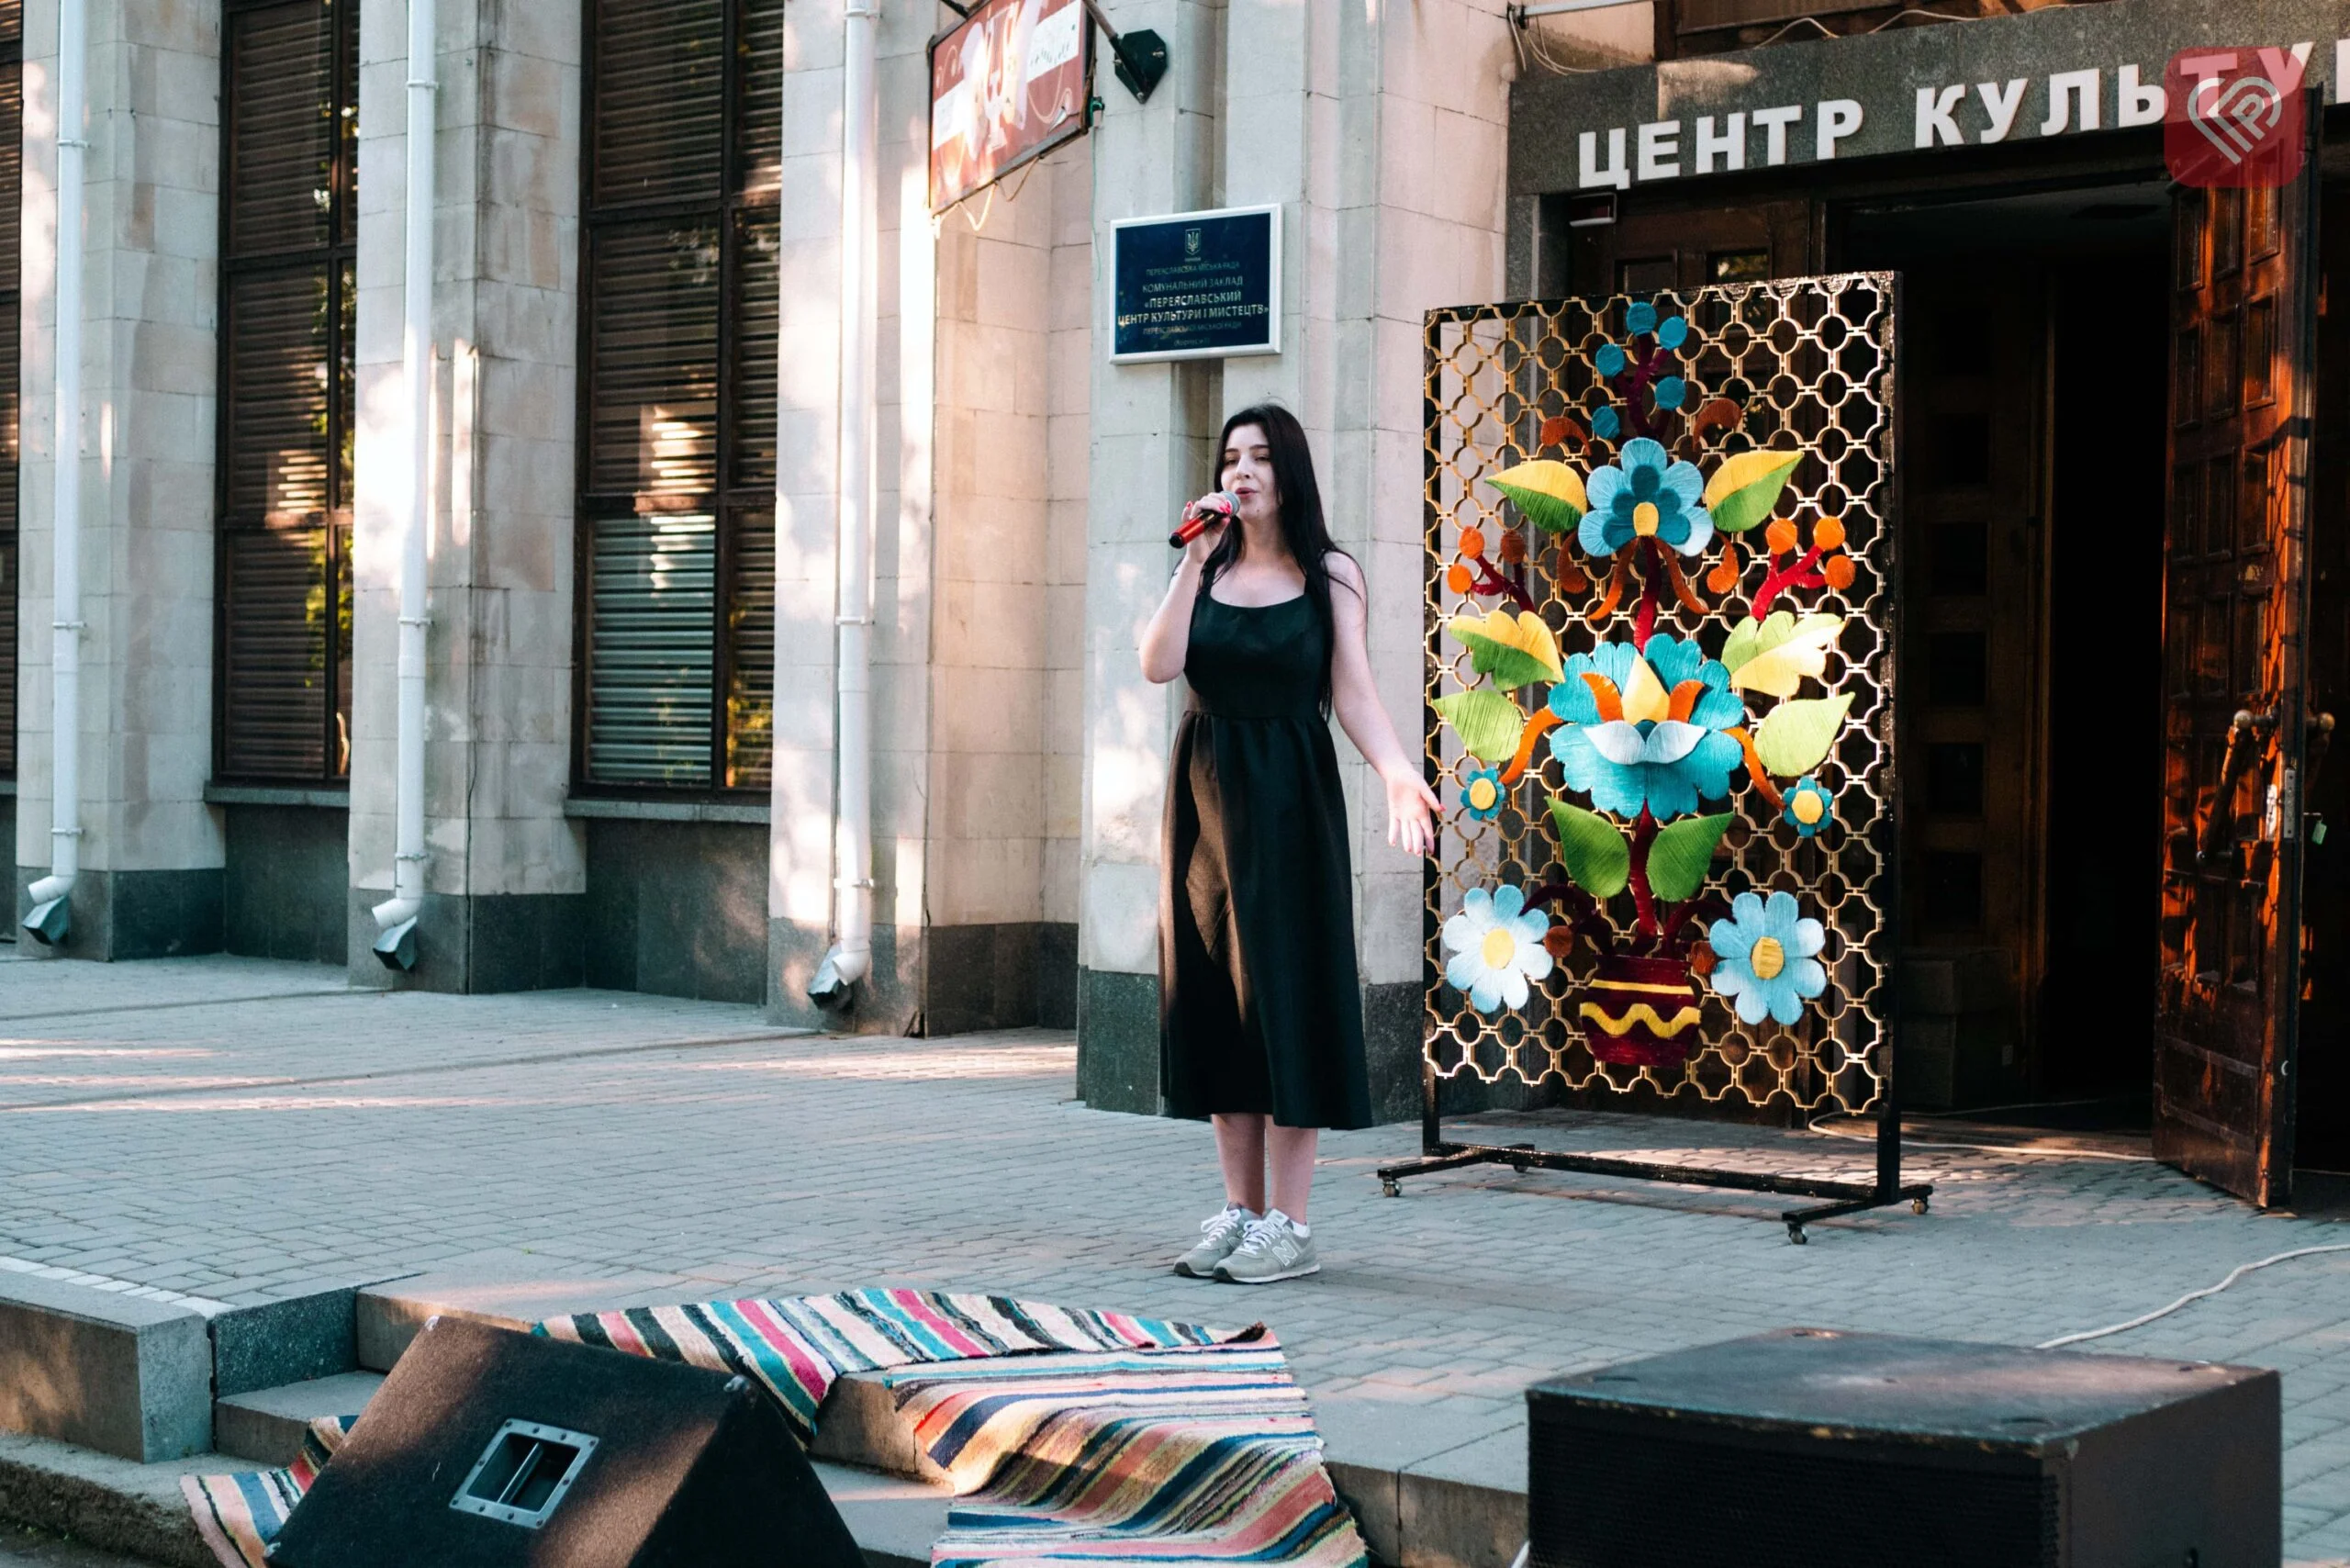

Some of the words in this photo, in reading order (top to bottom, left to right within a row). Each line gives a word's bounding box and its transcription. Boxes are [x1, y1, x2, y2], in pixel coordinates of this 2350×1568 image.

[1579, 99, 1863, 190] ЦЕНТР
[1142, 277, 1207, 293] КОМУНАЛЬНИЙ
[1210, 275, 1243, 288] ЗАКЛАД
[1118, 315, 1149, 327] ЦЕНТР
[1150, 308, 1202, 323] КУЛЬТУРИ
[1271, 1239, 1298, 1266] N
